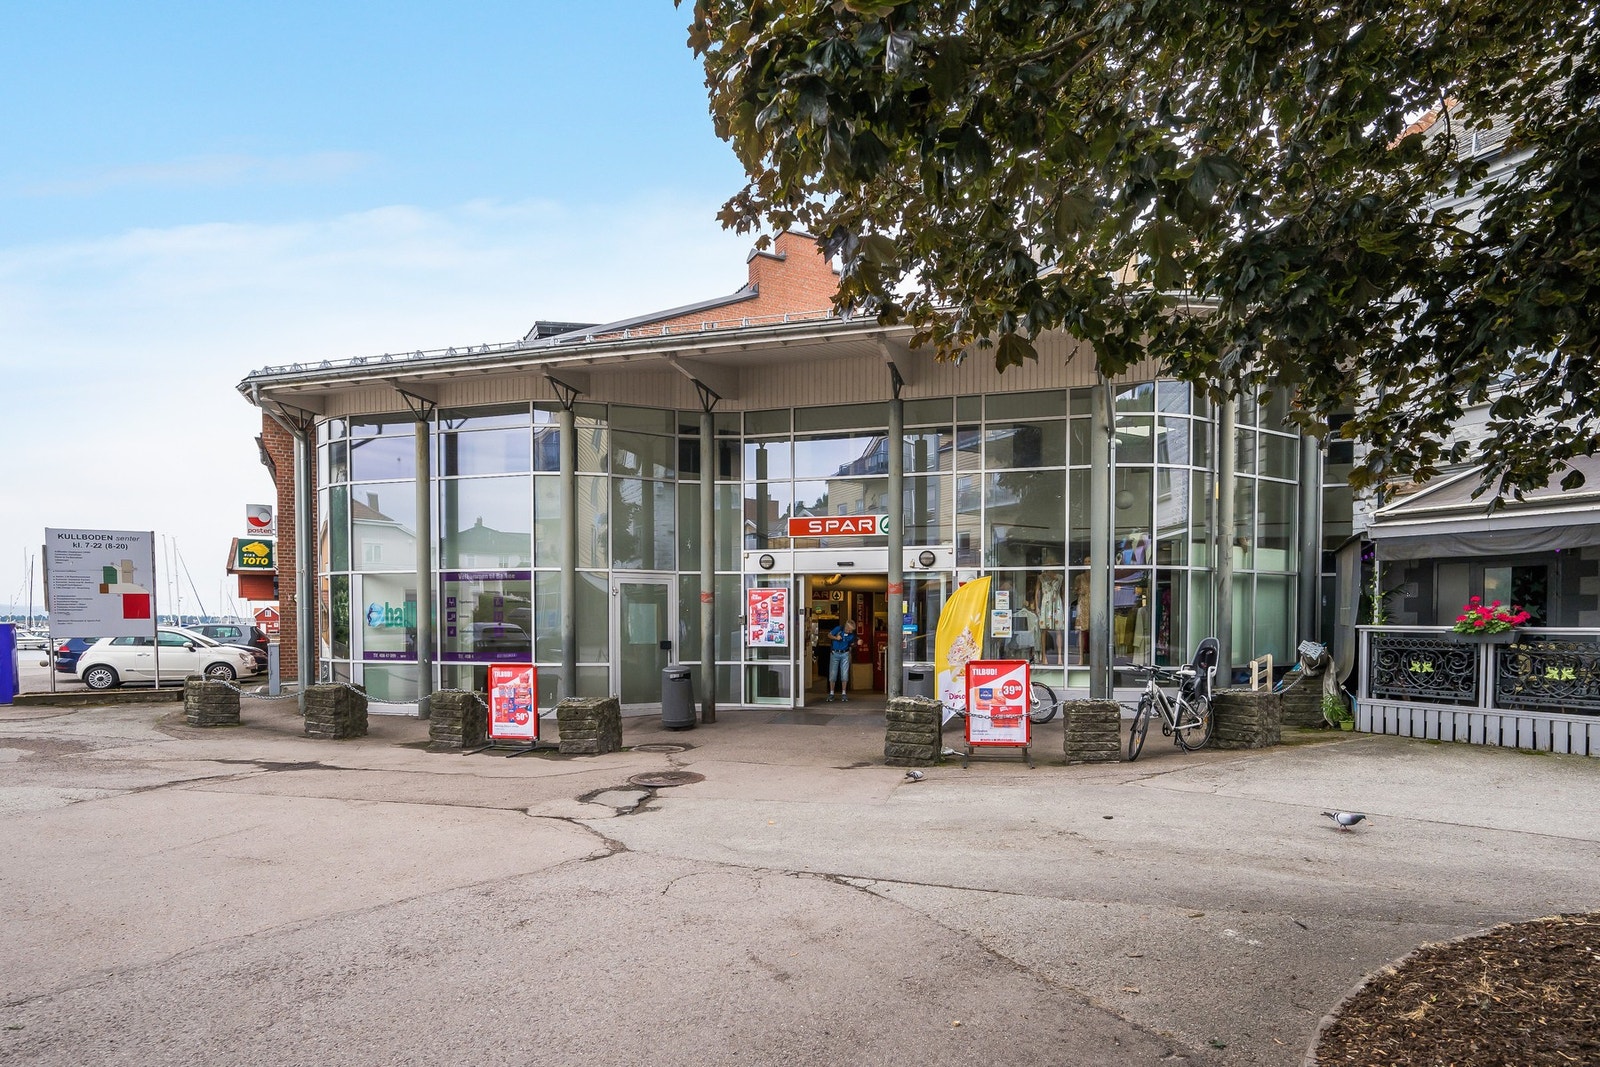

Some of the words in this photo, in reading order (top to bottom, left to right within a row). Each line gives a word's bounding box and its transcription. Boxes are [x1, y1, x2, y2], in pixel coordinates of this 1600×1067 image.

[808, 519, 873, 533] SPAR
[57, 533, 113, 541] KULLBODEN
[243, 557, 269, 565] TOTO
[972, 668, 998, 676] TILBUD!
